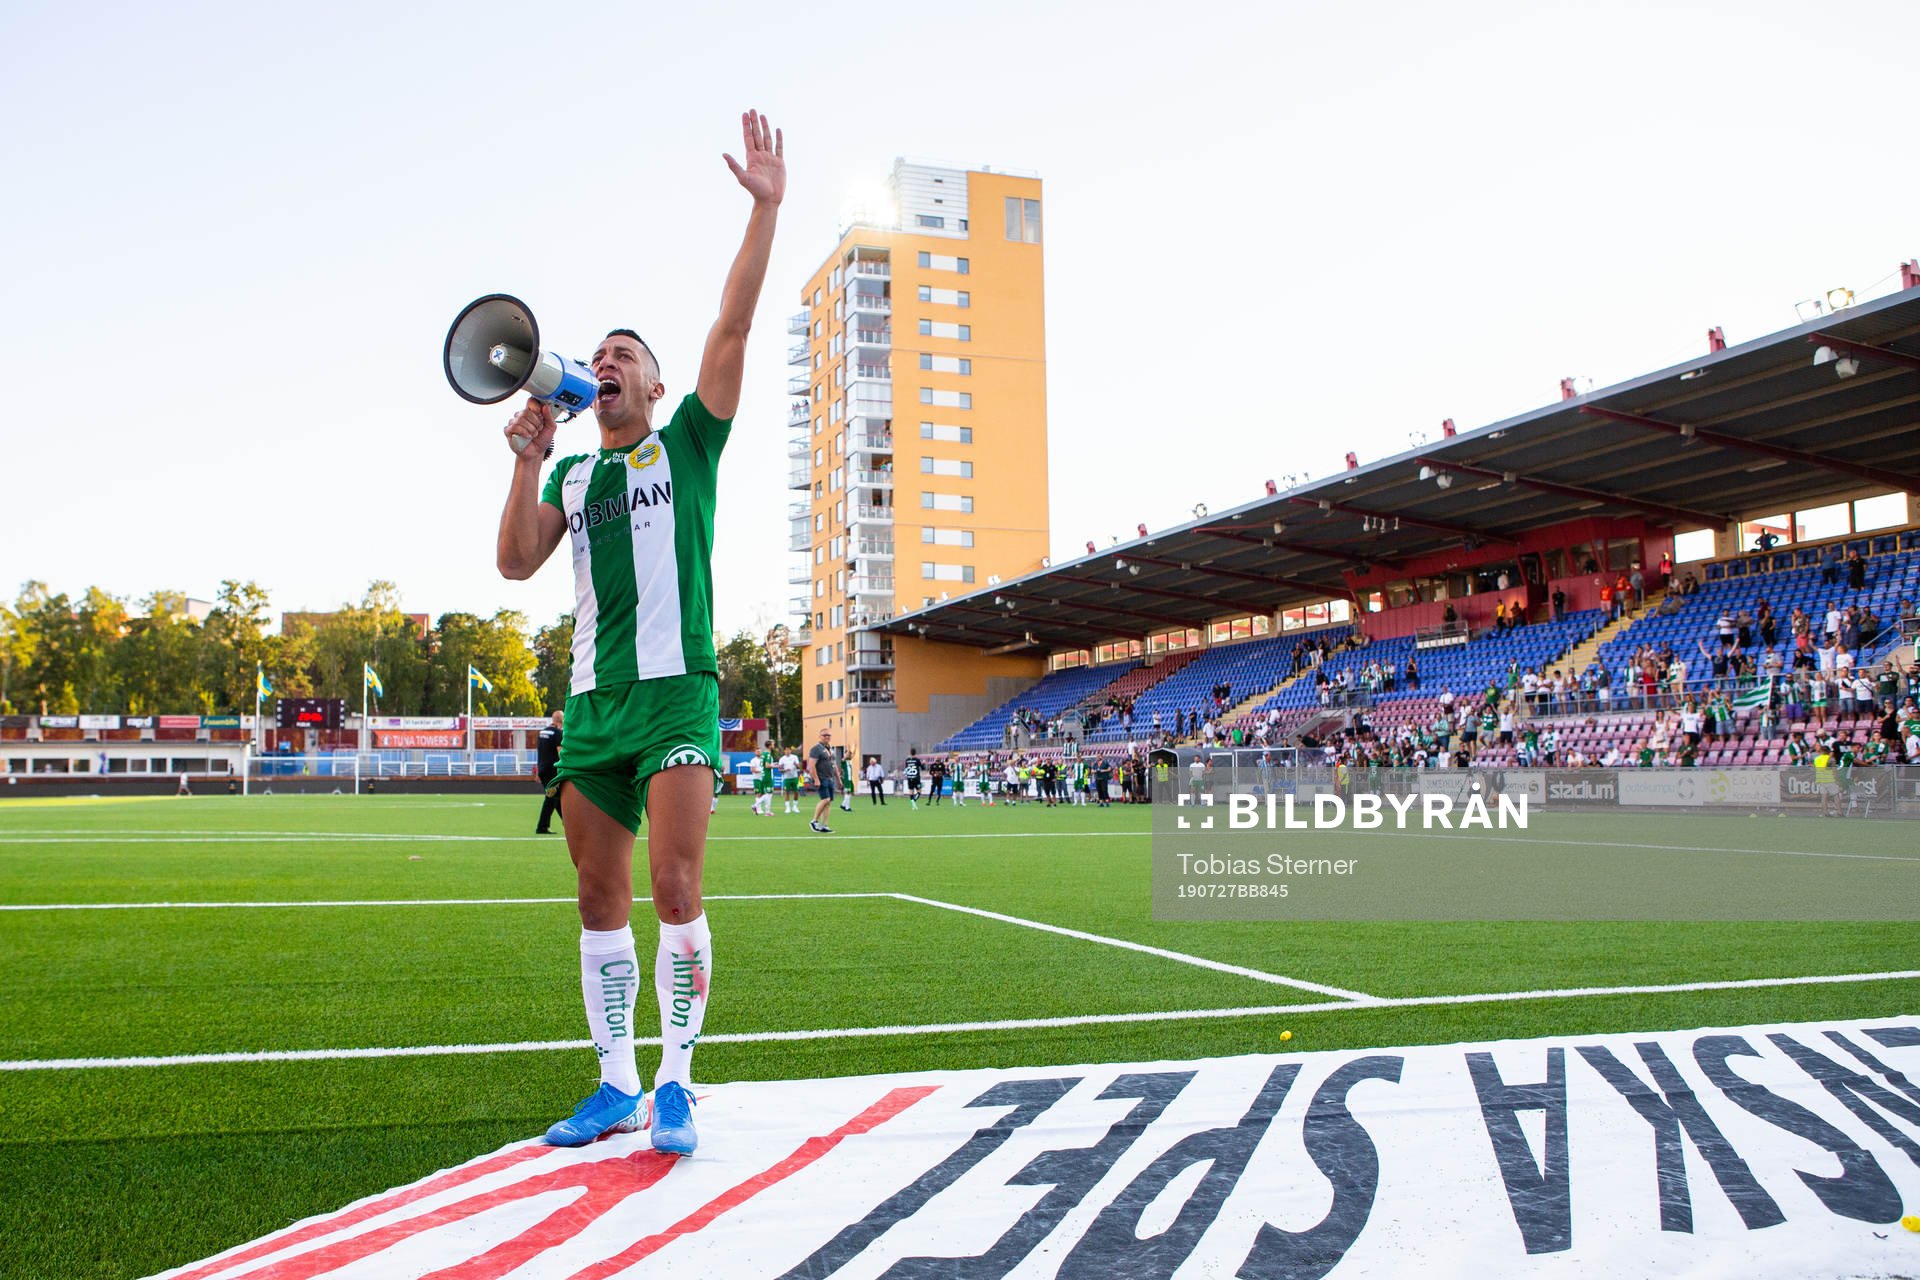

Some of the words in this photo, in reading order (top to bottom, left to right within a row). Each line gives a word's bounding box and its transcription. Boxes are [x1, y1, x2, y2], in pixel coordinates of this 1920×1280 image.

[566, 481, 671, 535] OBMAN
[416, 735, 449, 746] TOWERS
[1550, 780, 1615, 799] stadium
[600, 959, 635, 1038] Clinton
[1465, 1026, 1920, 1255] NSKA
